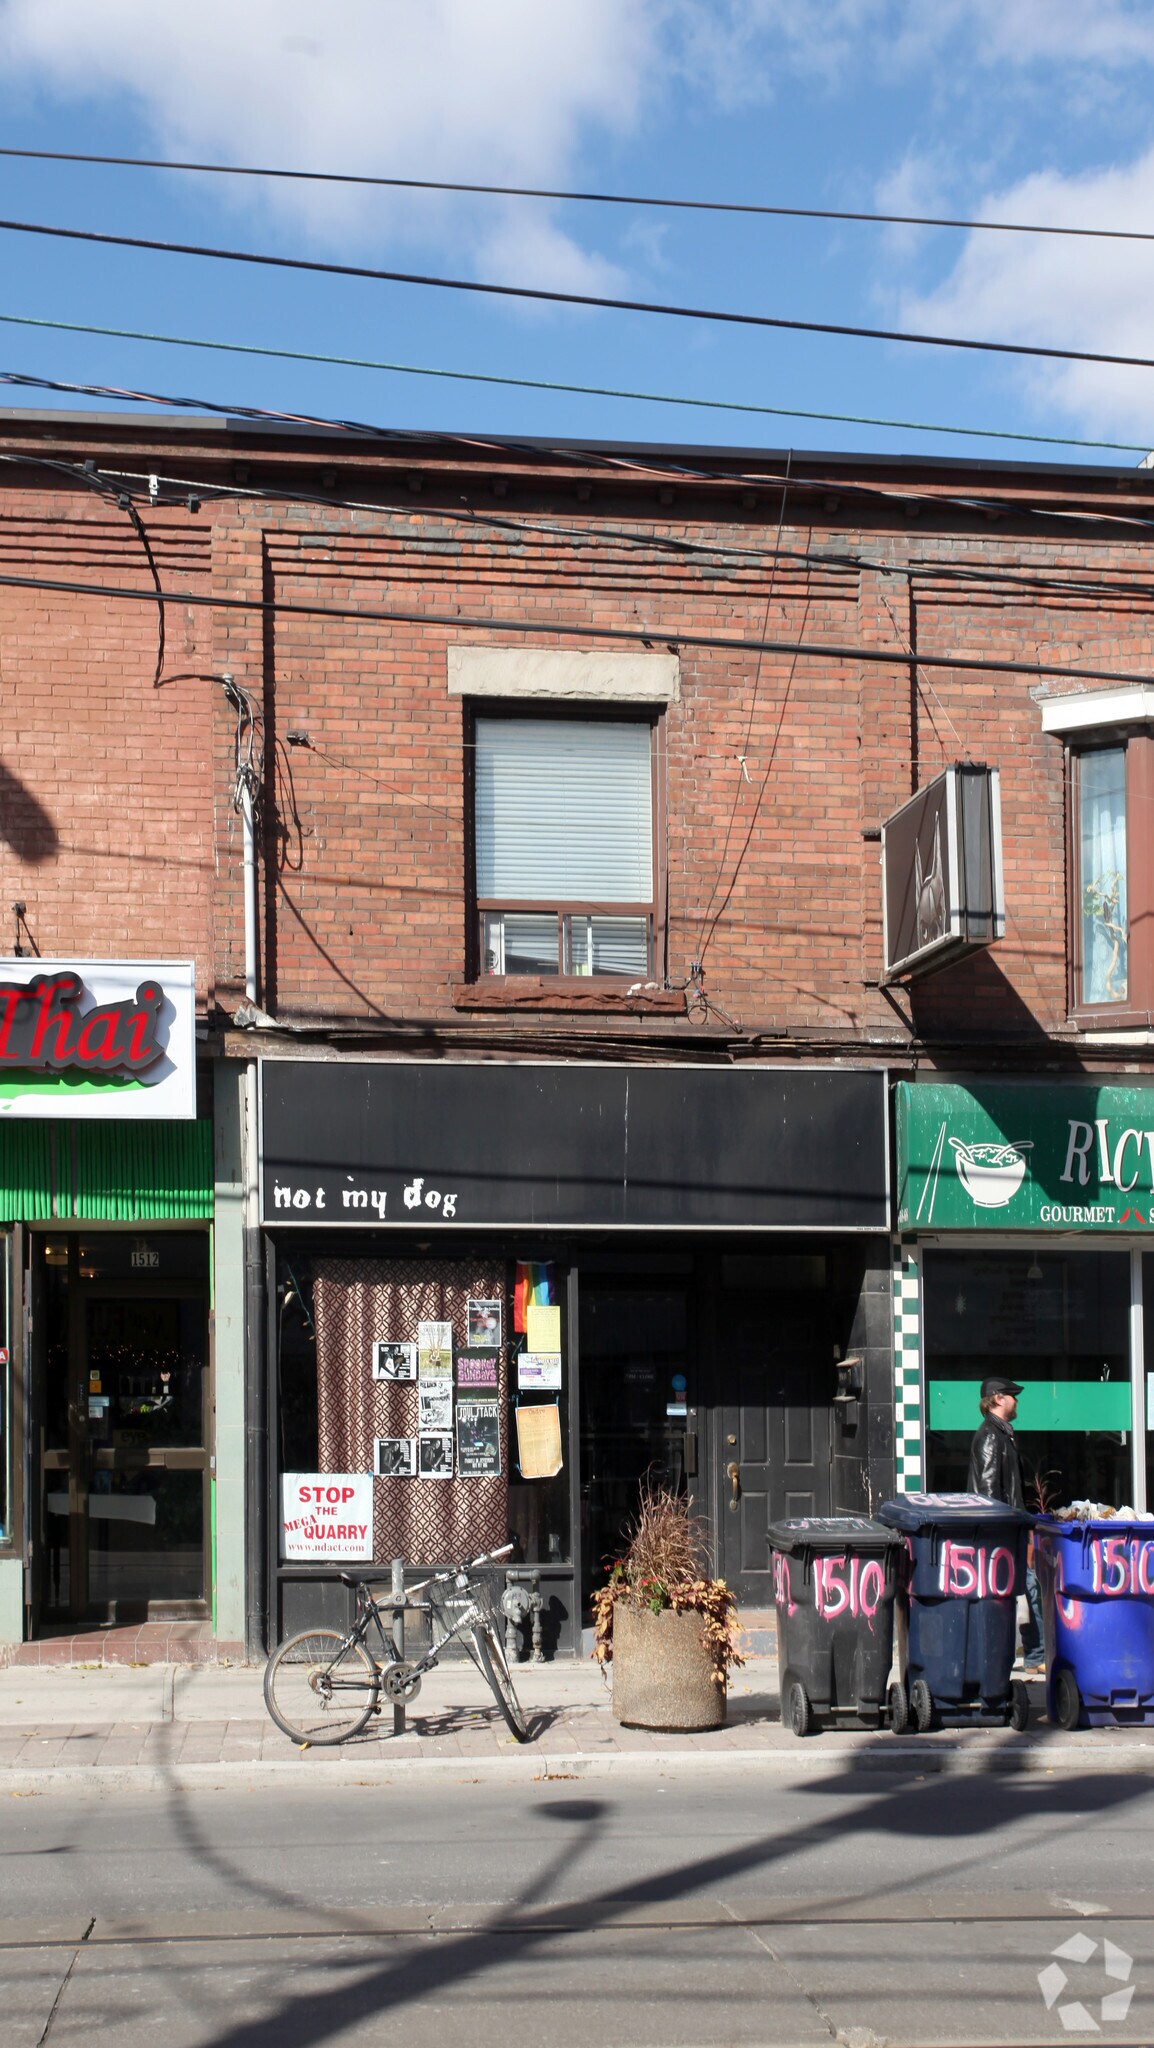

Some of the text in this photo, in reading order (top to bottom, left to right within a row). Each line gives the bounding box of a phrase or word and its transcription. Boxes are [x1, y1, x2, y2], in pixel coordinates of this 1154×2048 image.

[0, 979, 155, 1061] Thai
[274, 1178, 458, 1219] not my dog
[1040, 1205, 1116, 1223] GOURMET
[132, 1252, 159, 1267] 1512
[474, 1406, 498, 1418] STACK
[298, 1486, 355, 1504] STOP
[315, 1506, 338, 1516] THE
[283, 1514, 317, 1533] MEGA
[303, 1524, 368, 1540] QUARRY
[288, 1542, 364, 1552] www.ndact.com
[939, 1540, 1015, 1598] 1510
[813, 1555, 885, 1621] 1510
